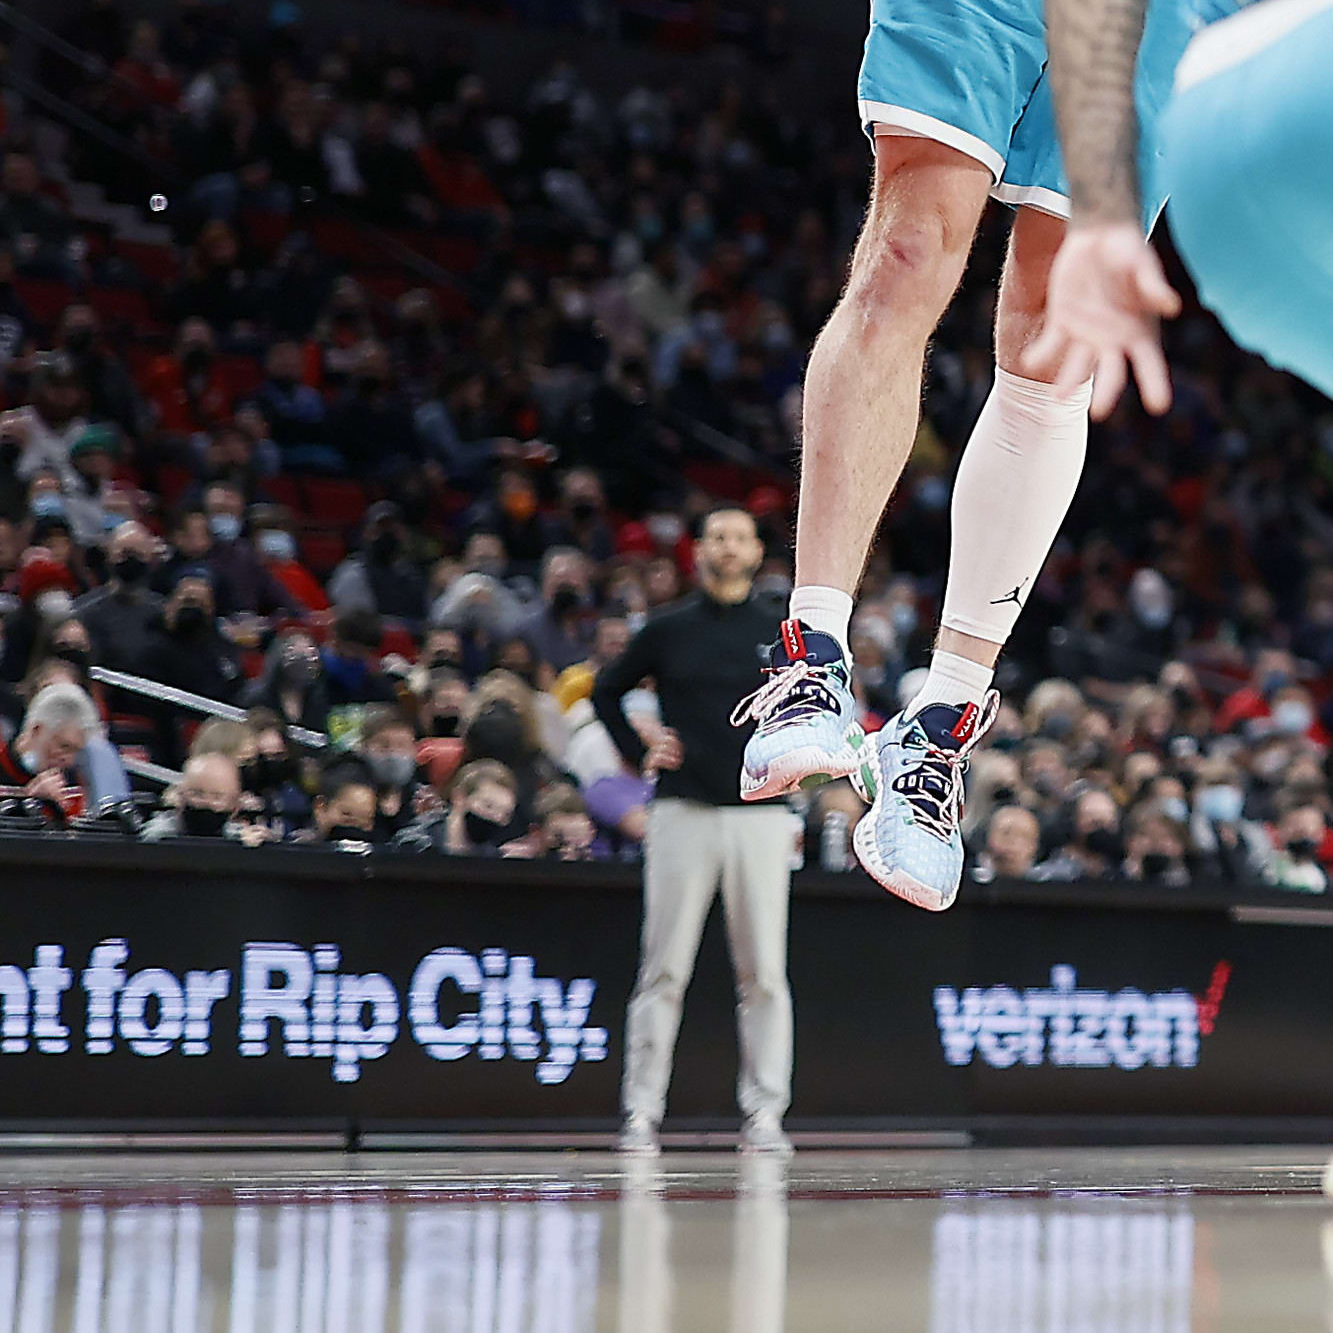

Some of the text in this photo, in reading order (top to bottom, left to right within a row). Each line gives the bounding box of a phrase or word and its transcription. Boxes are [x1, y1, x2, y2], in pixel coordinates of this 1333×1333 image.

[82, 937, 232, 1057] for
[238, 940, 401, 1084] Rip
[932, 963, 1200, 1070] verizon
